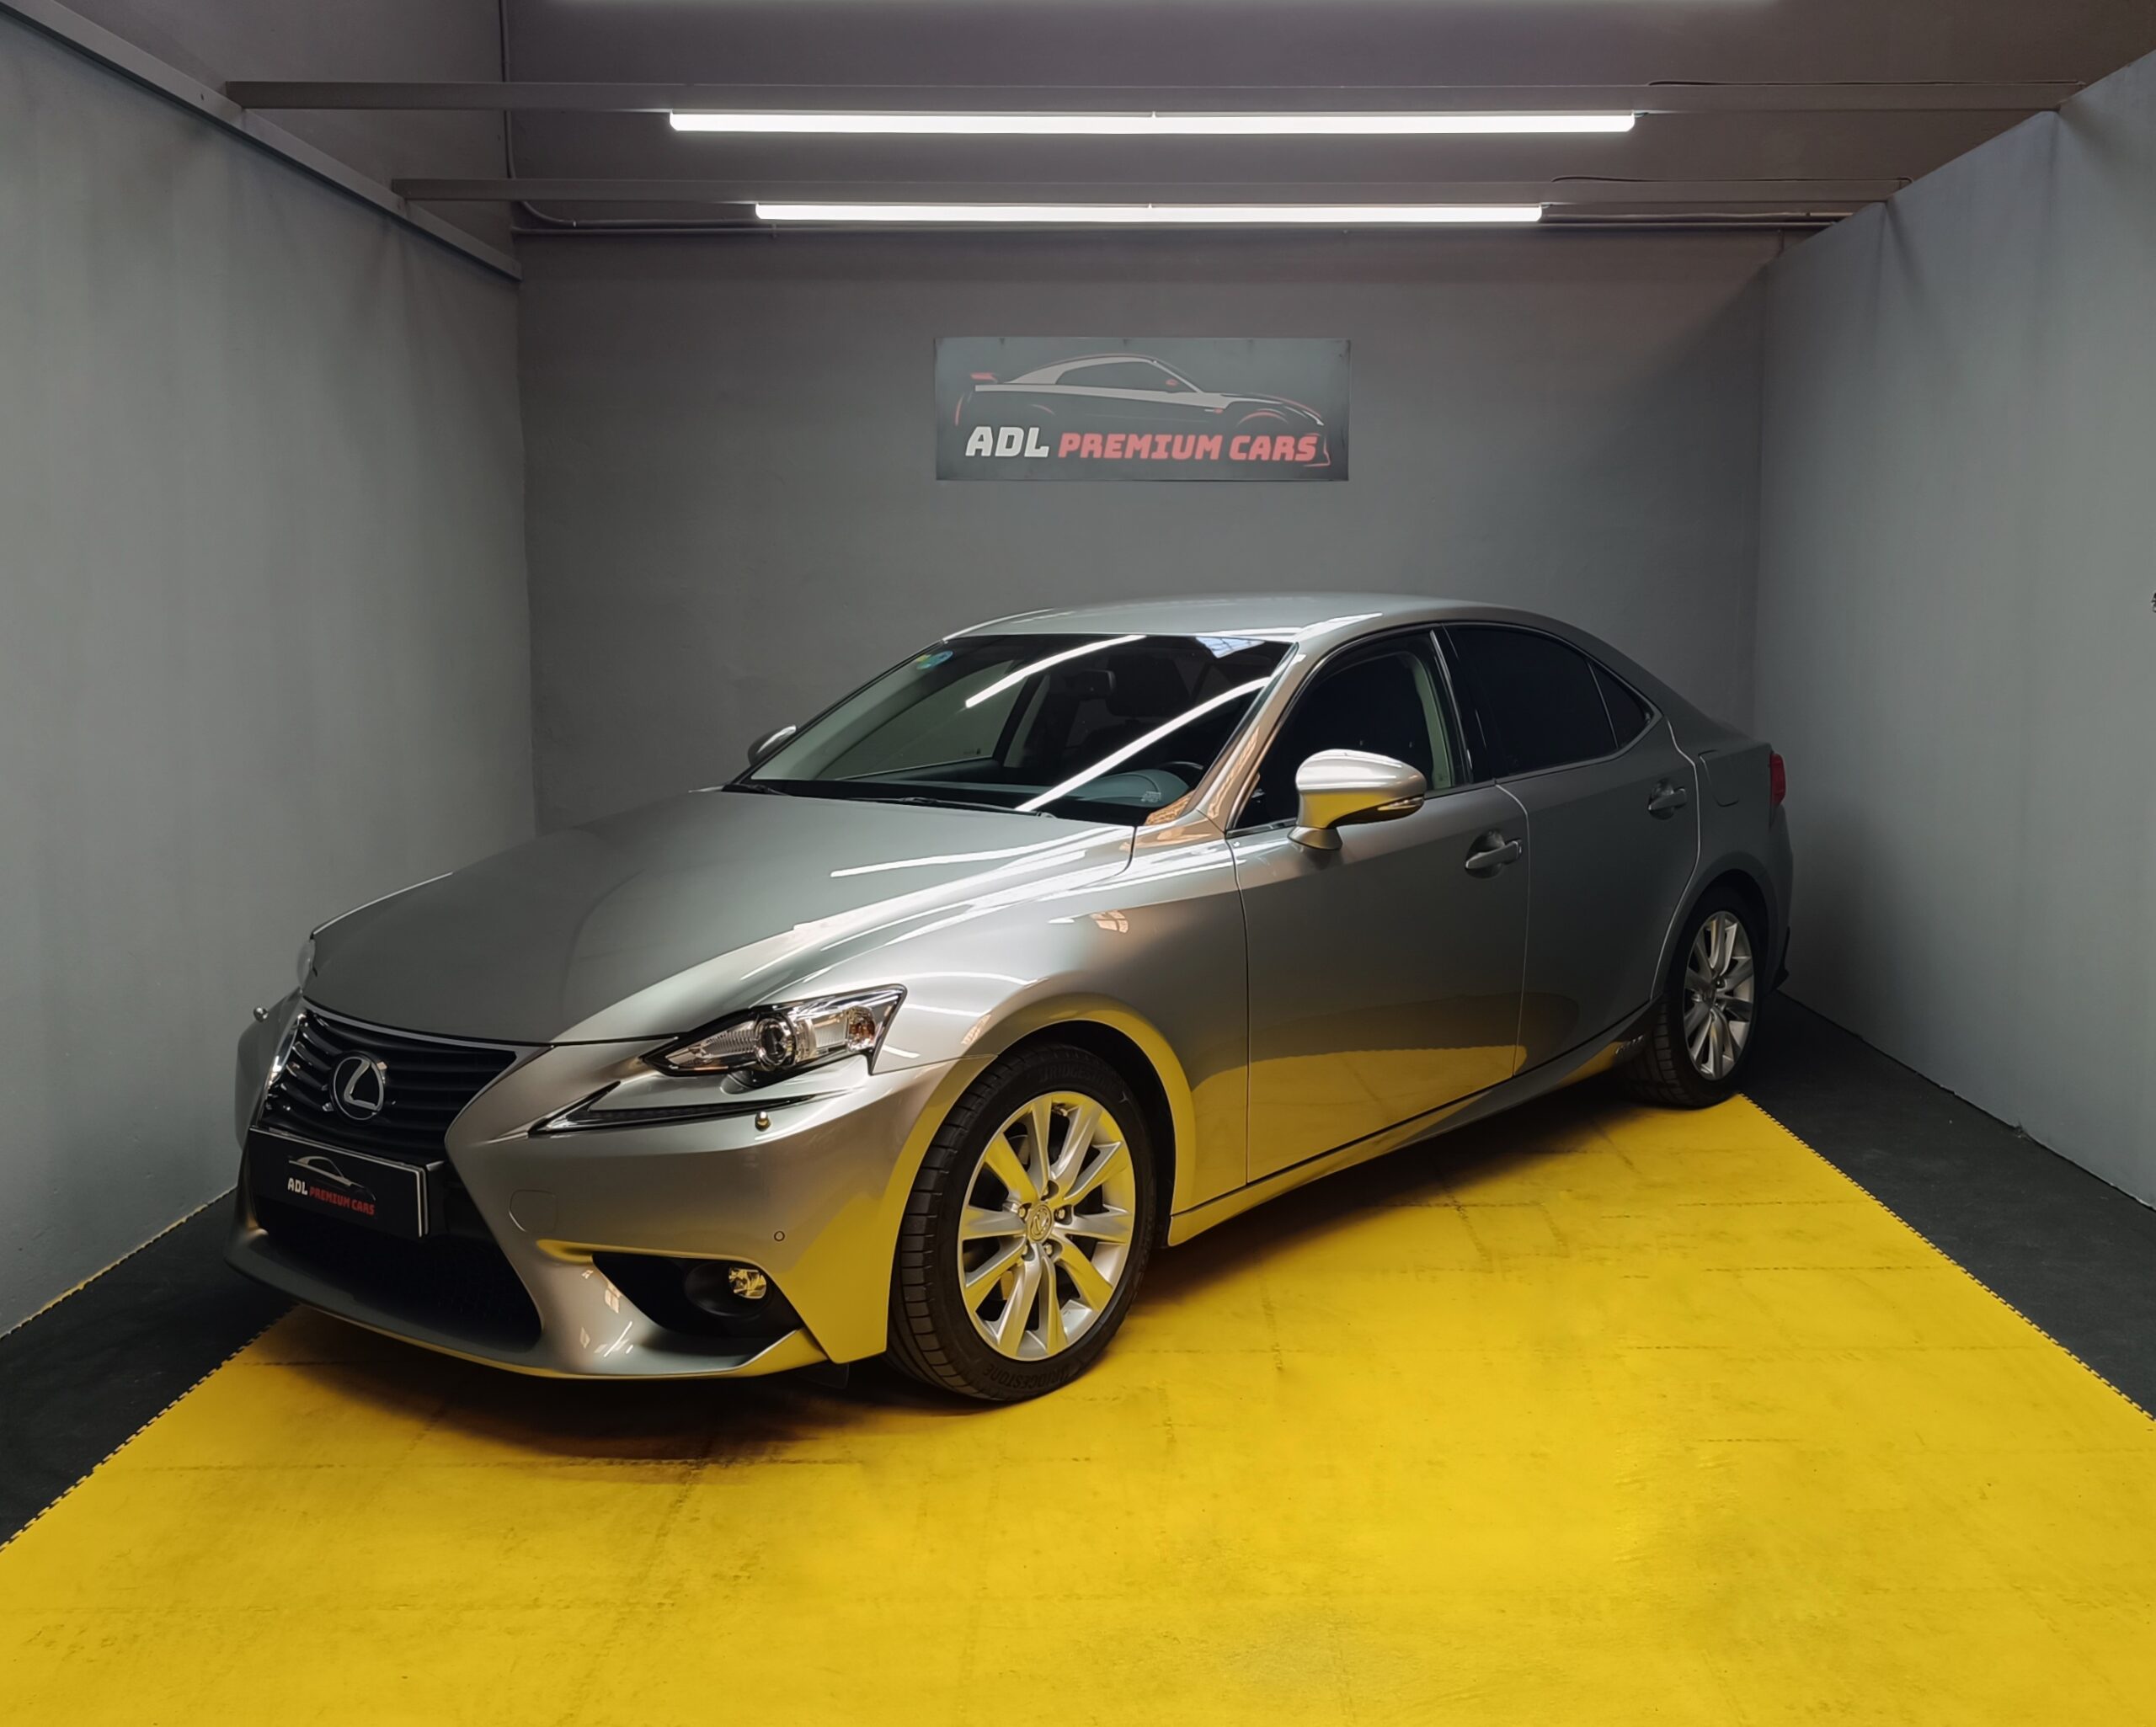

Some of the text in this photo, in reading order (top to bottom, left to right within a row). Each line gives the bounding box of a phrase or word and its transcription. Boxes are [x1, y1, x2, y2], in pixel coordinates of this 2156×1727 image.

[965, 426, 1317, 461] ADL PREMIUM CARS
[287, 1177, 376, 1216] ADL PREMIUM CARS
